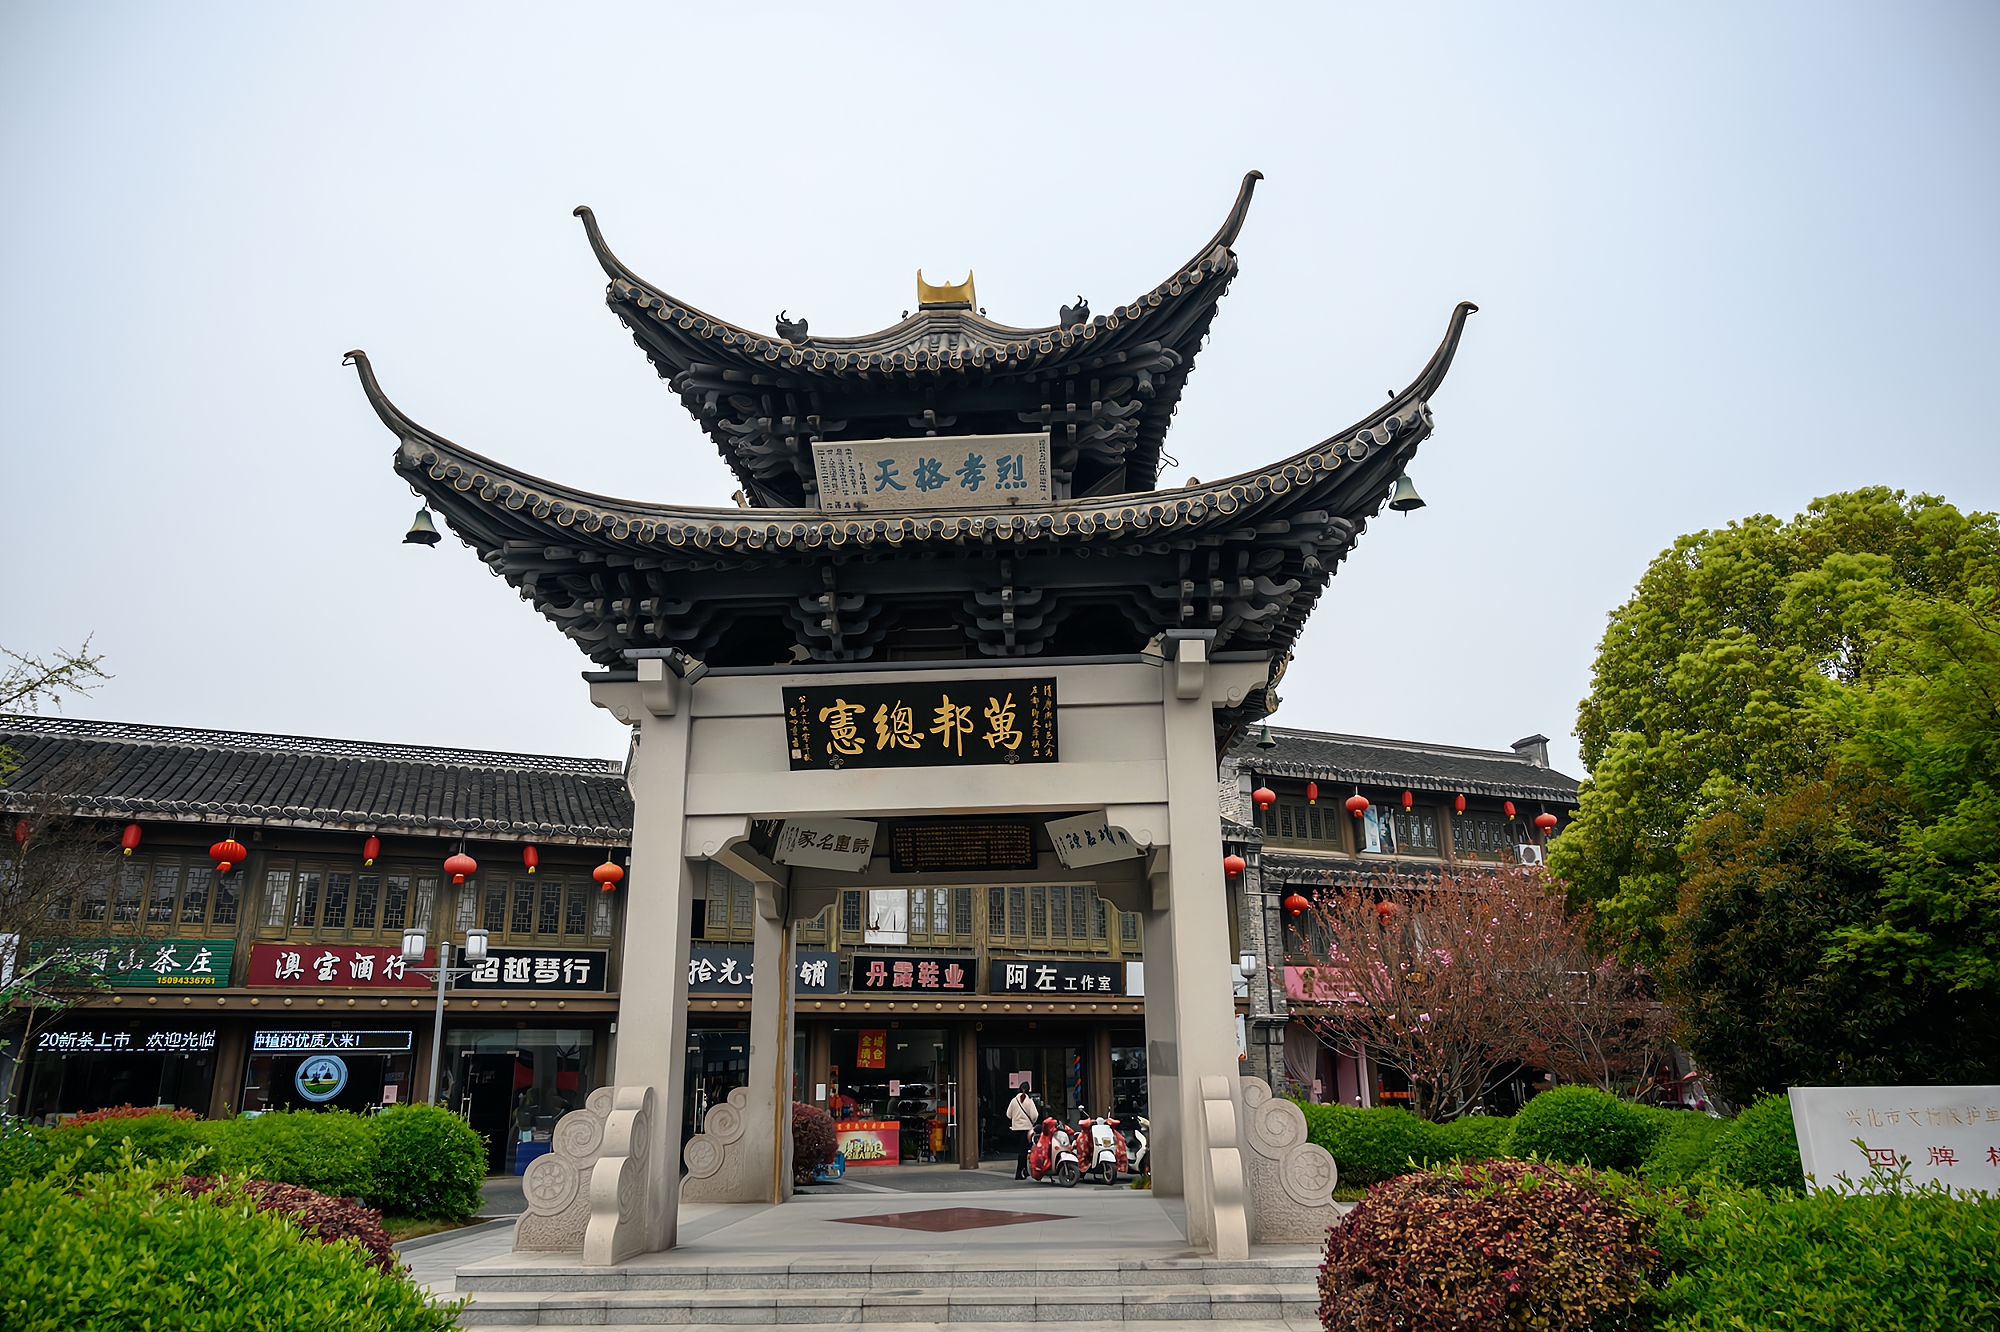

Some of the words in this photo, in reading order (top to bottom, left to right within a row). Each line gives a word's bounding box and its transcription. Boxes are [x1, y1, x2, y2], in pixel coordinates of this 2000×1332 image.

[275, 951, 407, 982] 澳宝酒行
[472, 956, 591, 984] 超越琴行
[866, 961, 965, 988] 丹露鞋业
[1005, 963, 1058, 991] 阿左
[1063, 974, 1112, 992] 工作室
[157, 976, 216, 985] 15094336761
[145, 1029, 217, 1047] 欢迎光临
